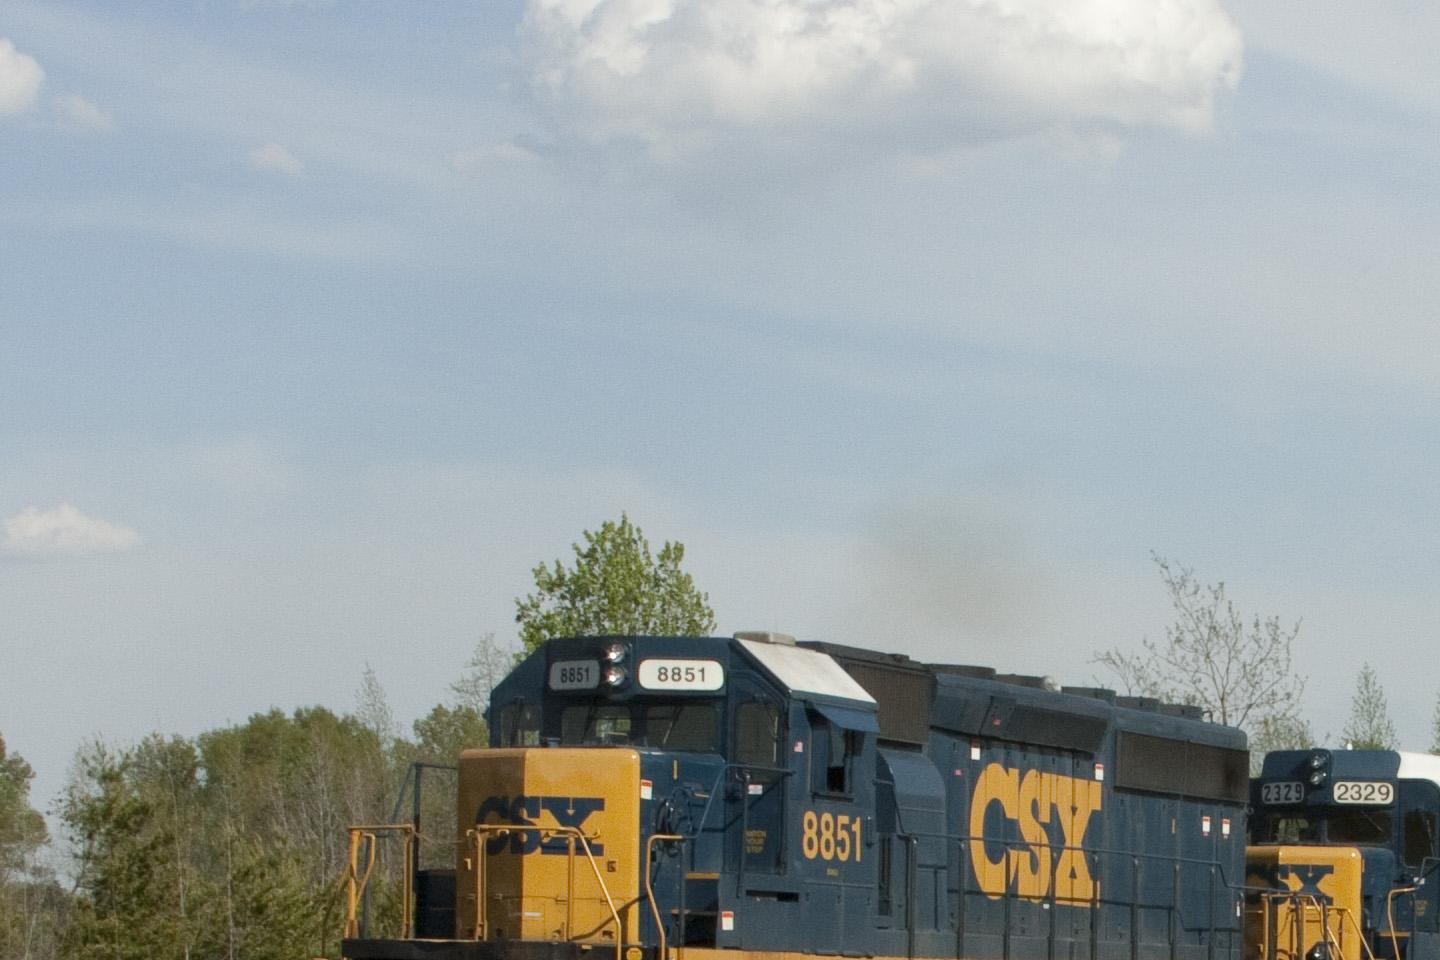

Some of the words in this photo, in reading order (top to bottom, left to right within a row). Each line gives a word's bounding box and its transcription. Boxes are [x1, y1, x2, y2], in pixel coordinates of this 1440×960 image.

[560, 667, 590, 683] 8851
[657, 667, 706, 682] 8851
[1264, 784, 1301, 801] 2329
[1337, 784, 1390, 801] 2329
[476, 796, 605, 856] CSX
[802, 810, 861, 862] 8851
[970, 762, 1102, 908] CSX
